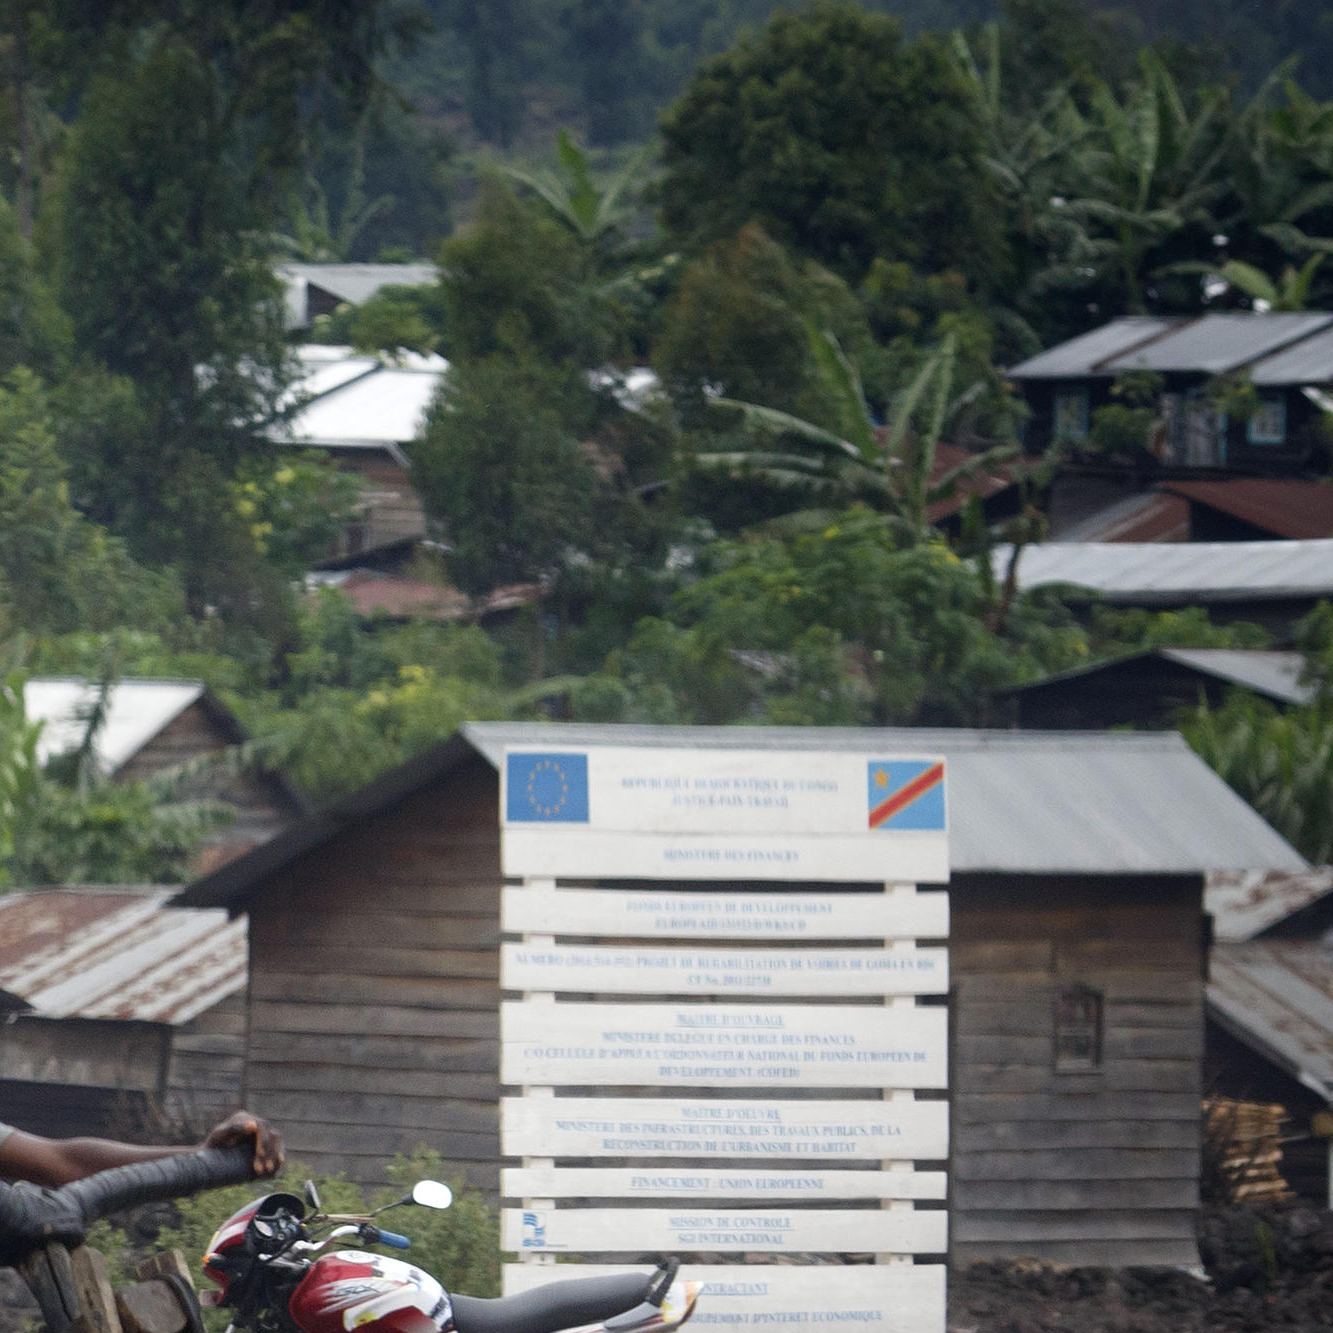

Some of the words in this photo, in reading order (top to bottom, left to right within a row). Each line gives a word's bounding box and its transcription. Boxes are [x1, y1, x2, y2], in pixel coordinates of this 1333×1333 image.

[556, 1121, 615, 1132] MINISTERE
[773, 1125, 821, 1136] TRAVAUX
[812, 1142, 856, 1153] HABITAT
[630, 1177, 710, 1189] FINANCEMENT
[718, 1179, 753, 1189] UNION
[755, 1179, 824, 1190] EUROPEENNE
[669, 1216, 714, 1228] MISSION
[716, 1217, 729, 1227] DE
[732, 1217, 791, 1228] CONTROLE
[698, 1233, 784, 1245] INTERNATIONAL
[701, 1283, 768, 1295] NTRACTANT
[812, 1310, 883, 1324] ECONOMIQUE
